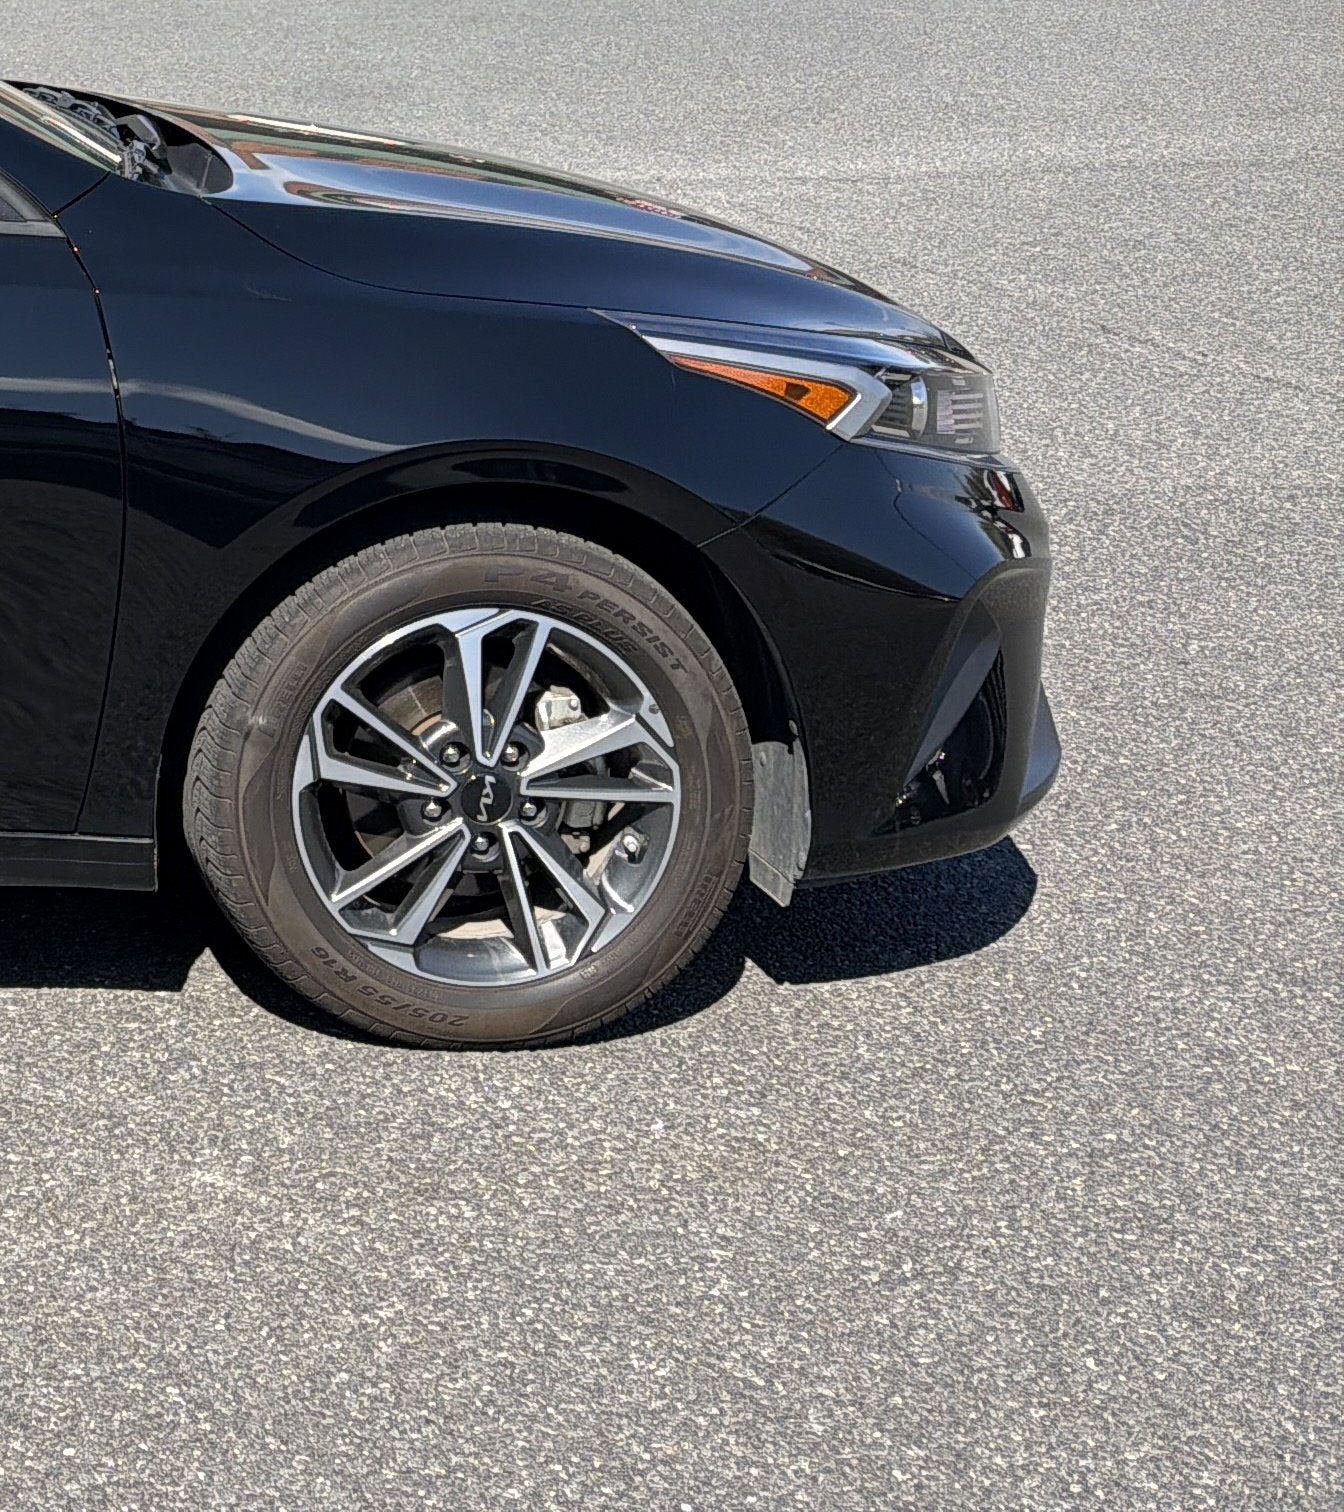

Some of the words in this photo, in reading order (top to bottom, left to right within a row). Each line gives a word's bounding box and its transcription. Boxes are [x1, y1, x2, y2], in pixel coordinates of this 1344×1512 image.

[577, 589, 690, 673] PERSIST
[476, 774, 497, 822] KIA
[310, 946, 358, 983] R16
[357, 985, 470, 1027] 205/55
